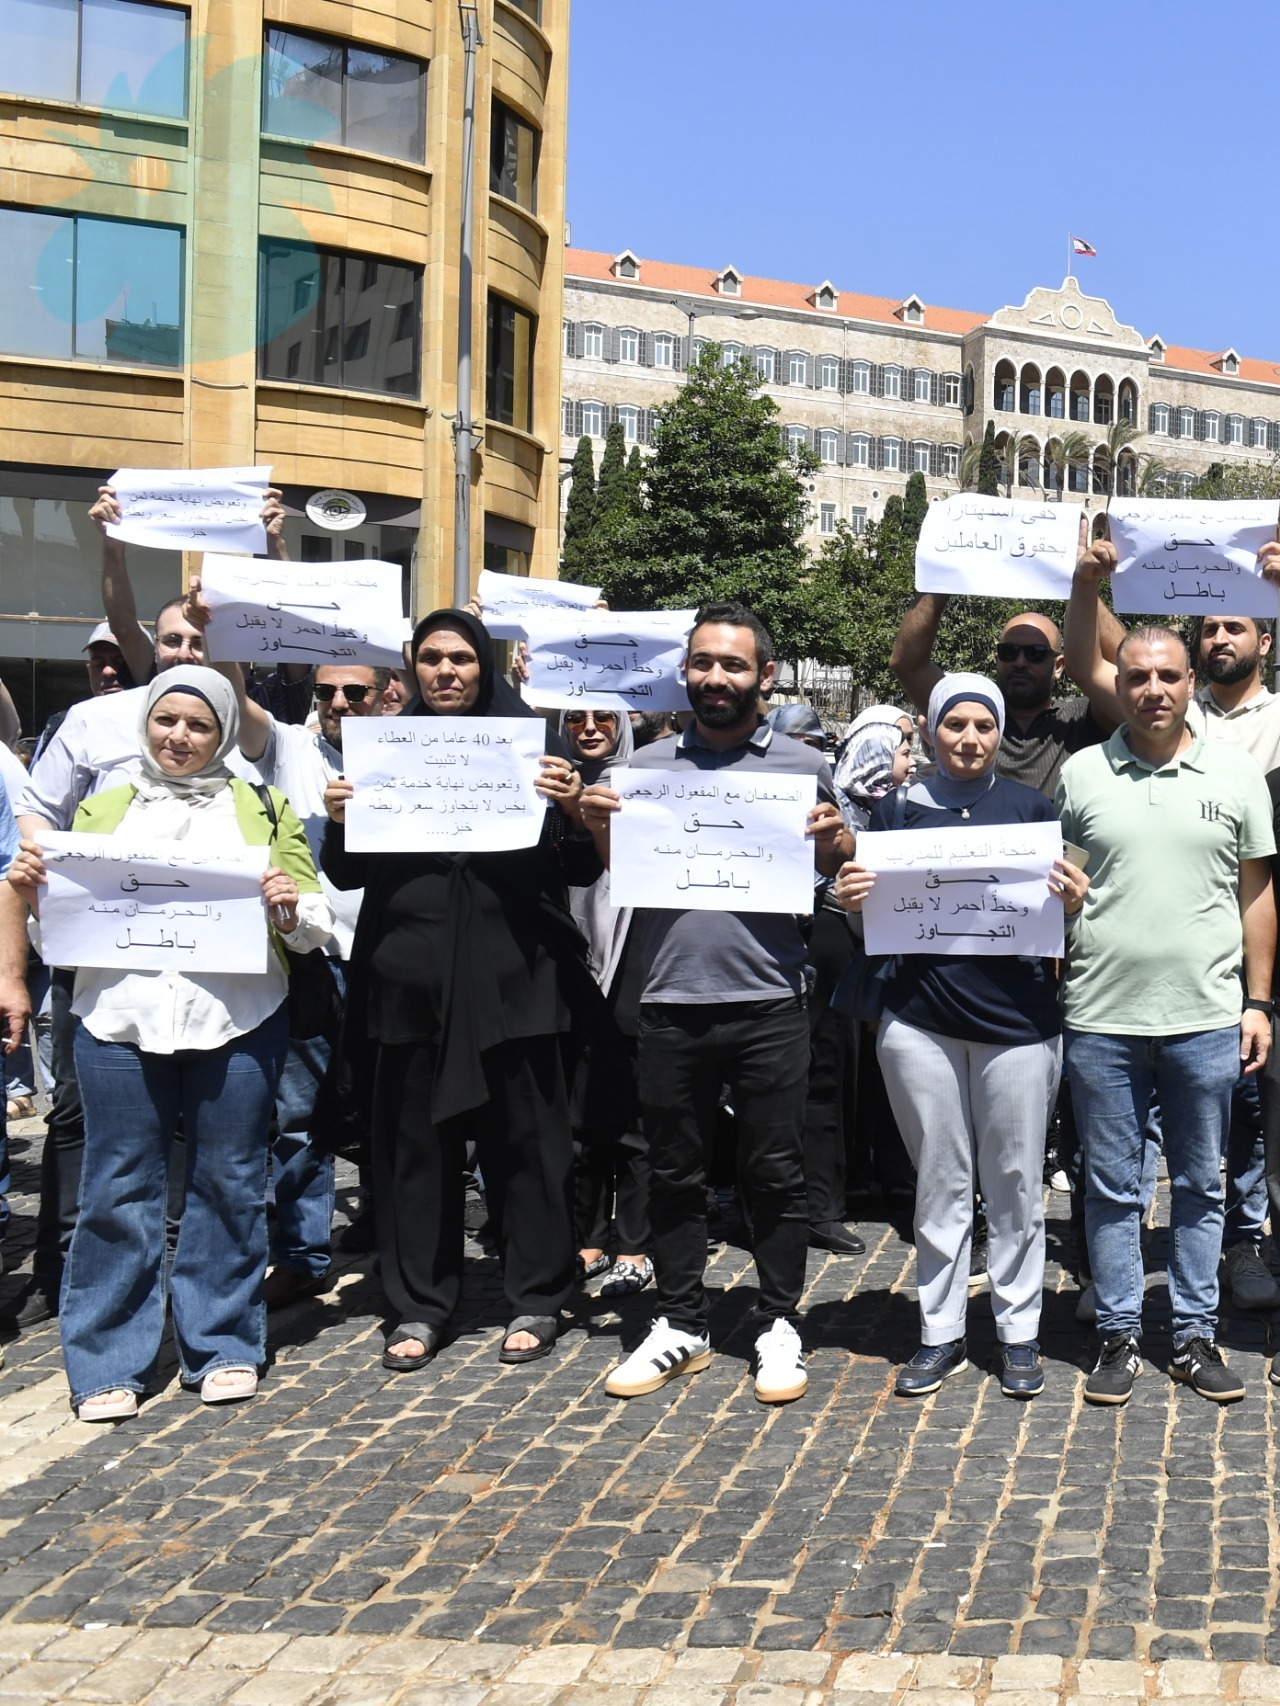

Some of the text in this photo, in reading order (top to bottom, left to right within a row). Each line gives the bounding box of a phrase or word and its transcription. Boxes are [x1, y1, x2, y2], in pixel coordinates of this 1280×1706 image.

[935, 532, 1066, 558] بحقوق العاملين
[1164, 533, 1215, 551] حق
[1142, 561, 1241, 575] والحرمان منه
[1164, 582, 1226, 602] باطل
[236, 614, 266, 629] يقبل
[271, 617, 283, 628] لا
[259, 637, 356, 658] التجاوز
[547, 656, 573, 671] يقبل
[579, 657, 589, 670] لا
[596, 657, 628, 674] أحمر
[565, 681, 652, 698] التجاوز
[378, 732, 512, 748] بعد 40 عاما من العطاء
[425, 754, 469, 768] لا تثبيت
[374, 776, 520, 793] وتعويض نهاية خدمة ثمن
[623, 785, 802, 804] الضعفان مع المفعول الرجعي
[408, 803, 433, 814] سعر
[439, 800, 478, 814] يتجاوز
[483, 800, 491, 811] لا
[497, 802, 526, 814] بخس
[684, 812, 744, 833] حق
[654, 844, 773, 862] والحرمان منه
[120, 874, 190, 892] حق
[676, 869, 750, 894] باطل
[89, 903, 221, 921] والحرمان منه
[894, 897, 924, 913] يقبل
[931, 897, 941, 911] لا
[949, 896, 985, 915] أحمر
[116, 928, 196, 954] باطل
[915, 923, 1015, 942] التجاوز
